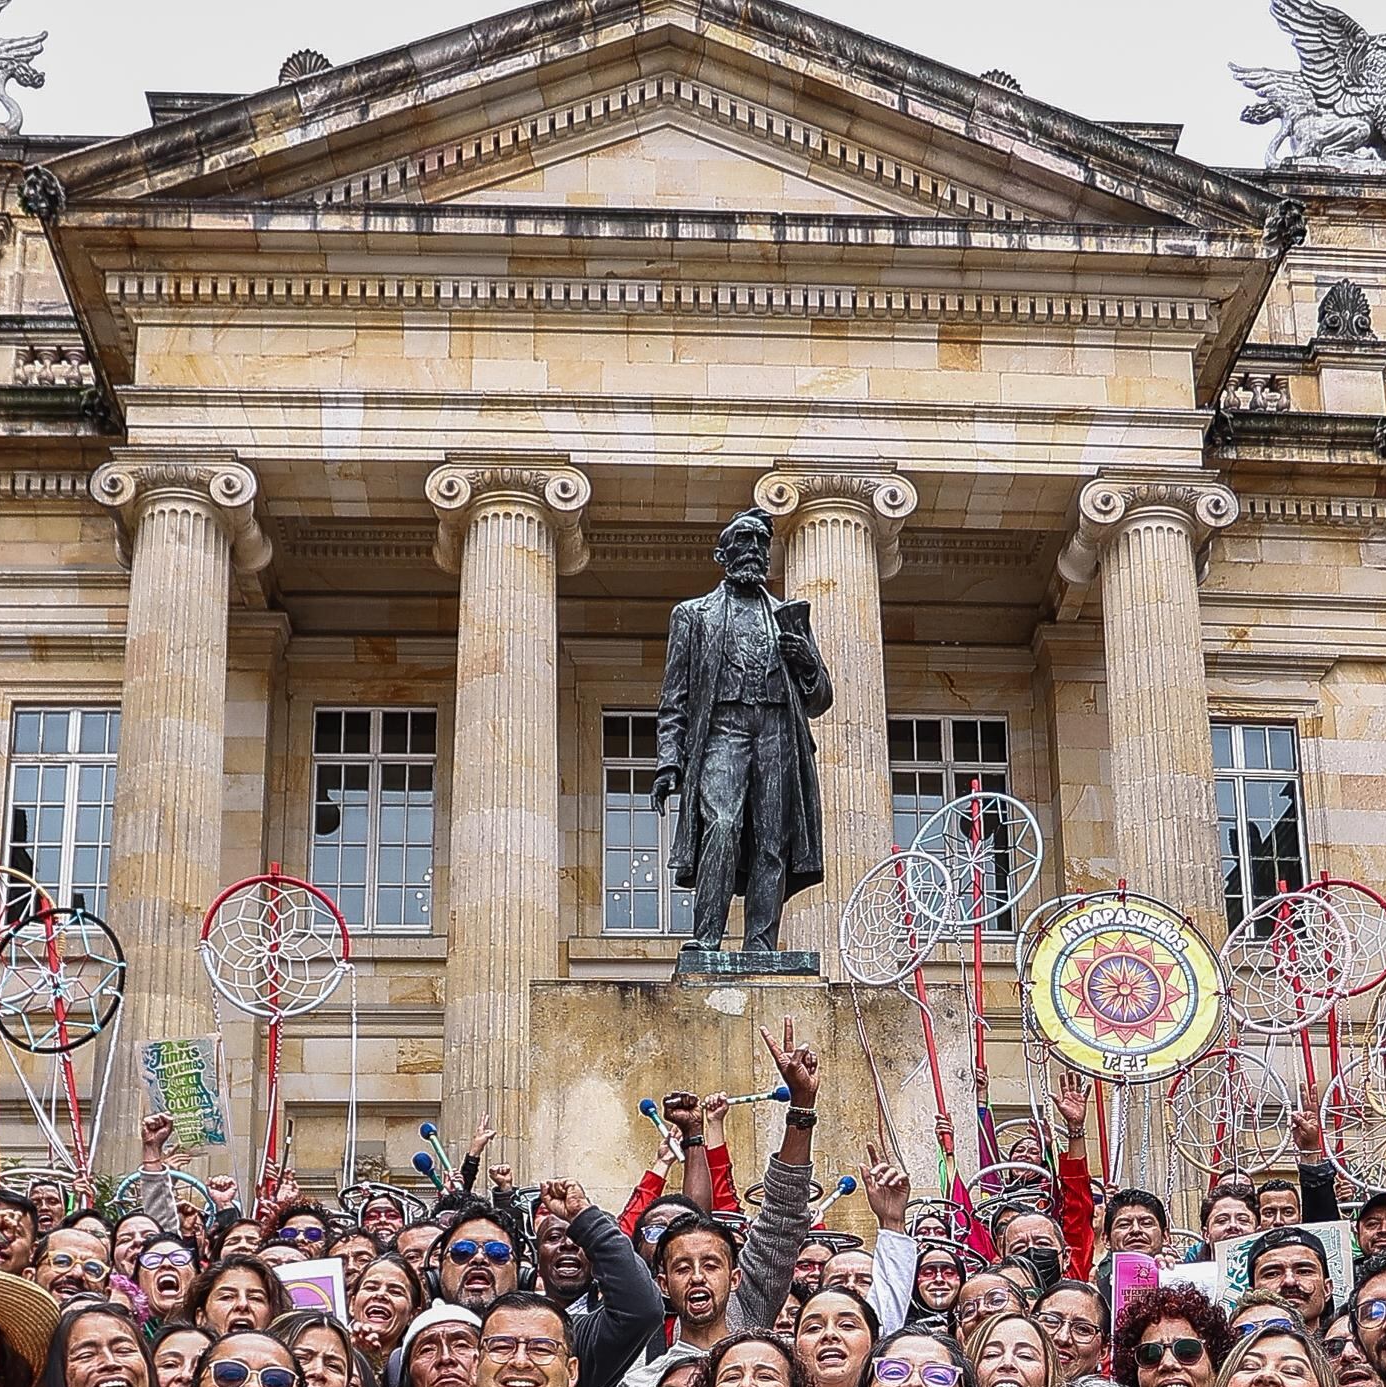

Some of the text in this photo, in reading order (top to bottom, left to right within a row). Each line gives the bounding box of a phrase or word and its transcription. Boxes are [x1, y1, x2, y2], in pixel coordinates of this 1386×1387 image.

[1059, 908, 1189, 953] ATRAPASUEÑOS
[156, 1059, 205, 1079] movemos
[168, 1095, 209, 1109] OLVIDA
